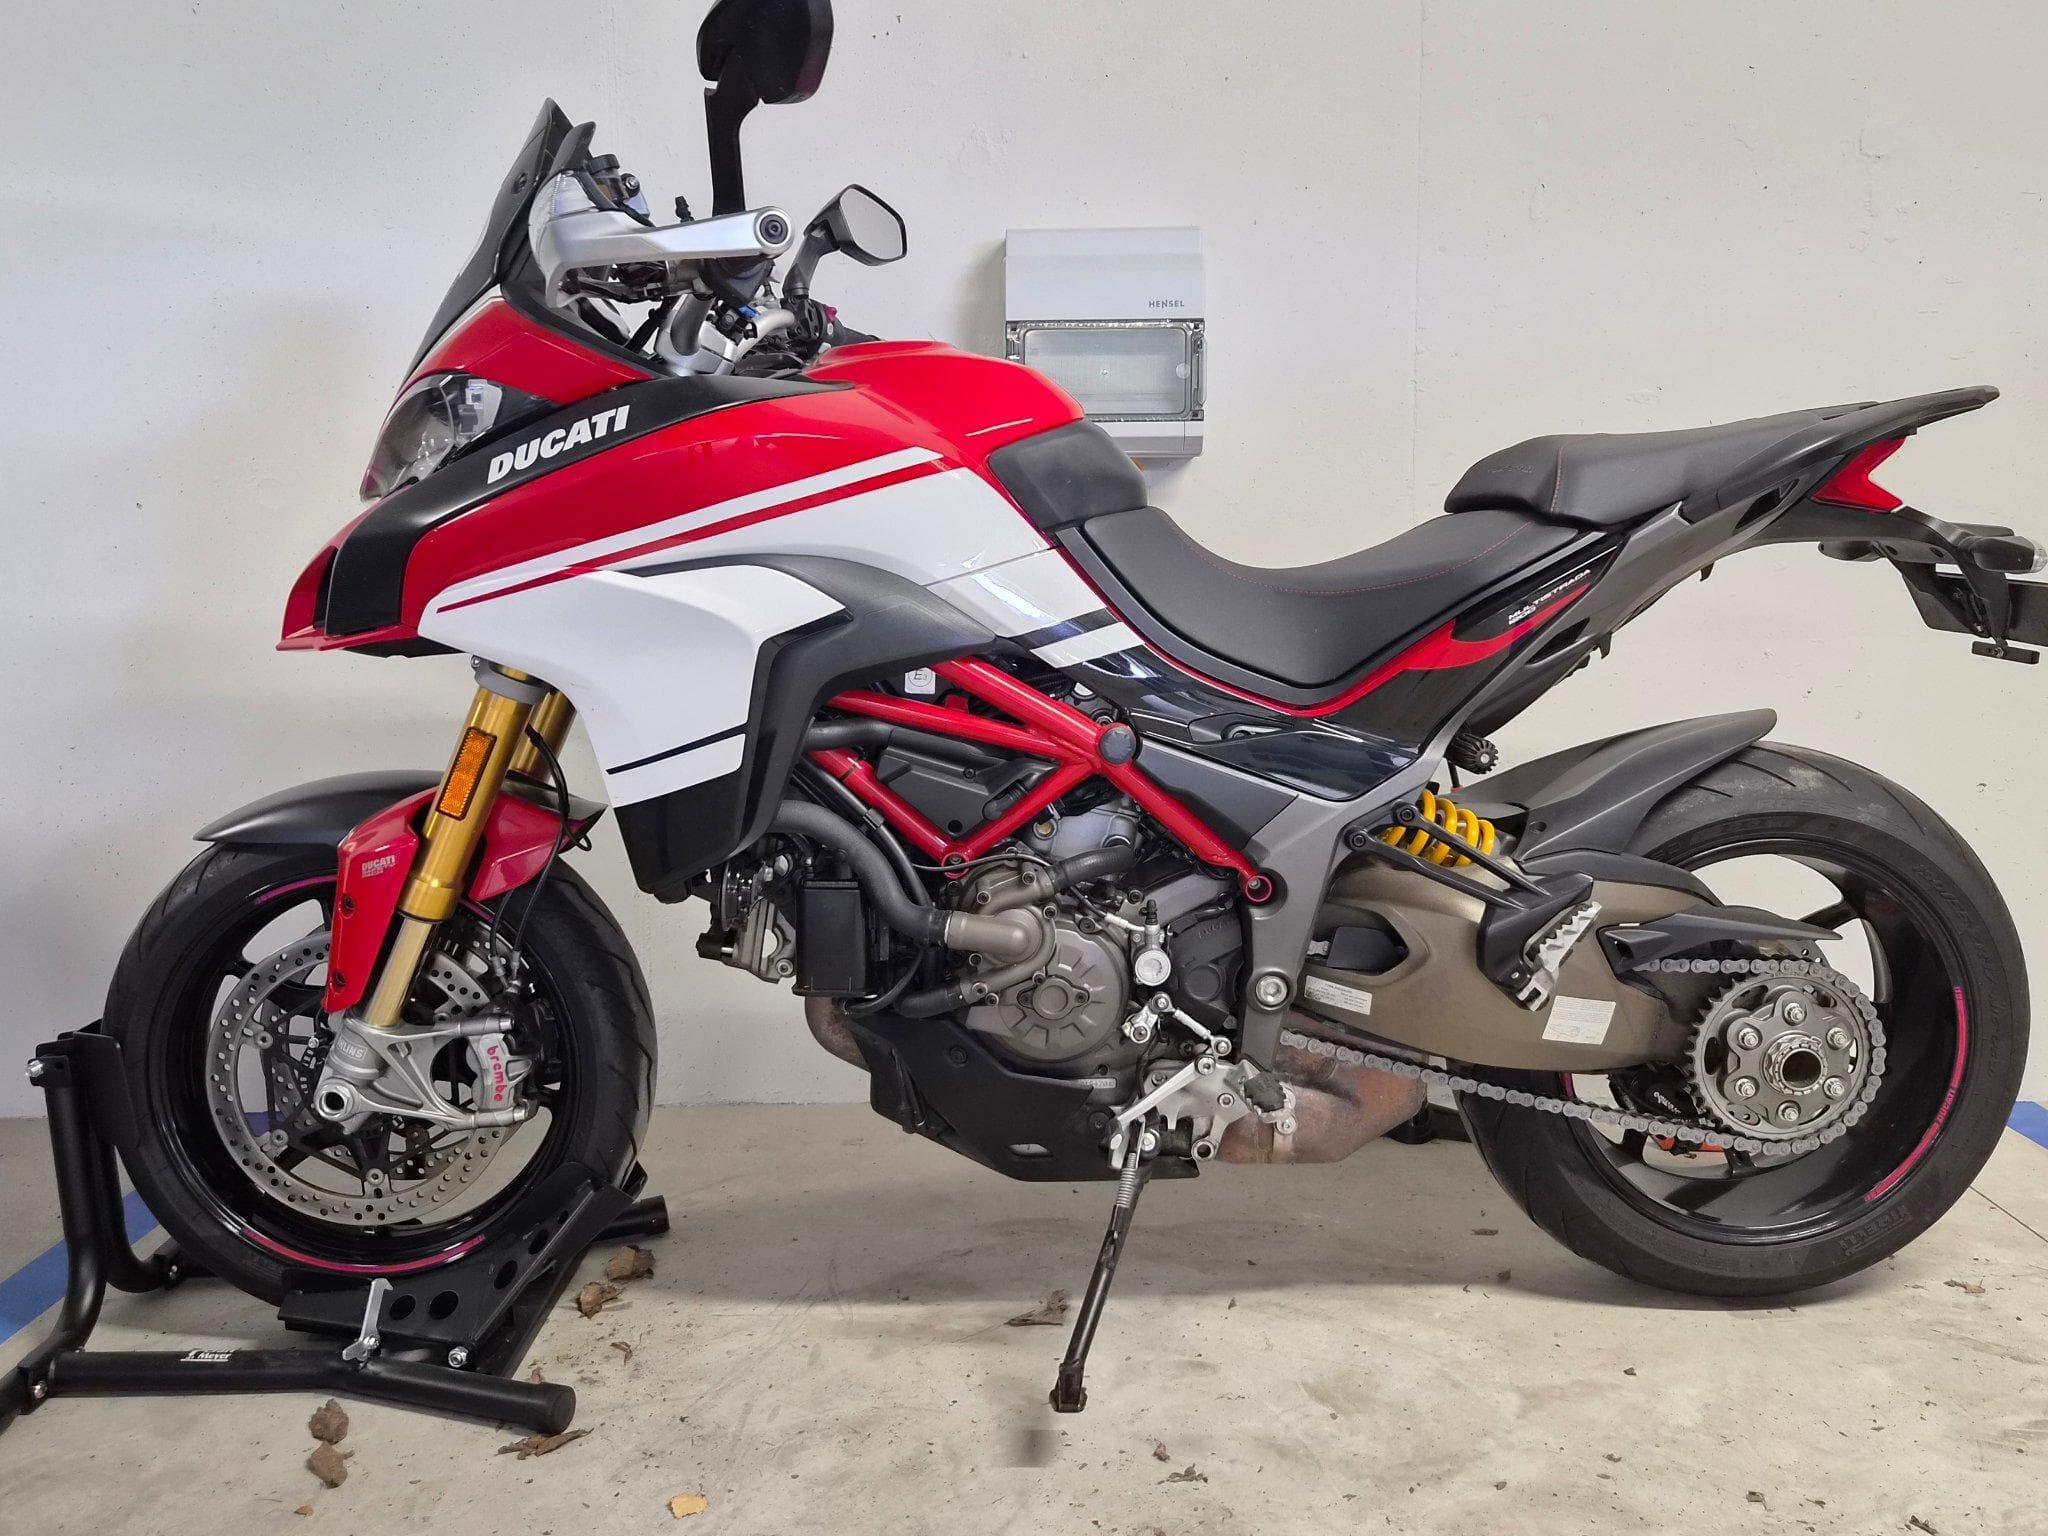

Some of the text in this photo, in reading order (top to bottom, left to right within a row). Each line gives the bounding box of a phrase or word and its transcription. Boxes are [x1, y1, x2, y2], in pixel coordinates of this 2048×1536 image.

[1149, 300, 1184, 308] HENSEL
[487, 404, 630, 484] DUCATI
[362, 855, 396, 870] DUCATI
[487, 1045, 507, 1101] brembo
